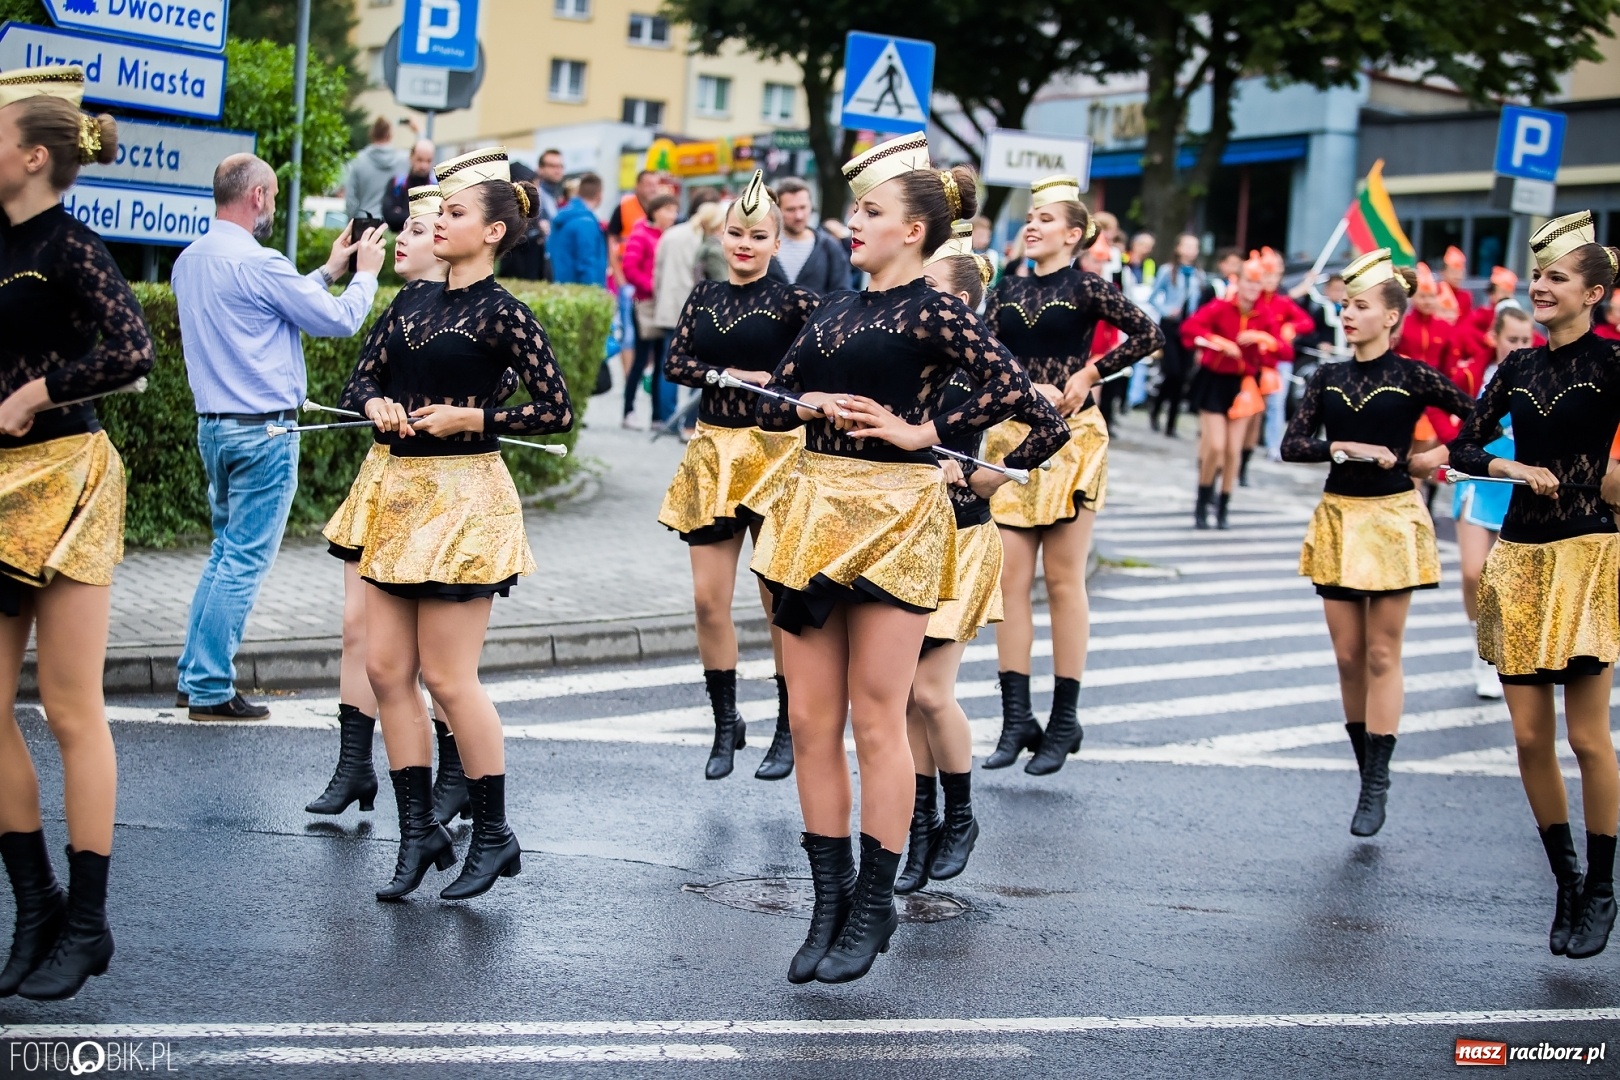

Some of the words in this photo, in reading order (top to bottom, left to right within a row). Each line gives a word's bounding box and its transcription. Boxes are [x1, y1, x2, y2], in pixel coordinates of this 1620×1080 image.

[108, 0, 216, 32] Dworzec
[416, 0, 460, 54] P
[26, 43, 102, 82] Urd
[118, 56, 205, 98] Miasta
[115, 140, 180, 171] oczta
[1511, 115, 1552, 168] P
[1006, 149, 1066, 170] LITWA
[131, 200, 210, 235] Polonia
